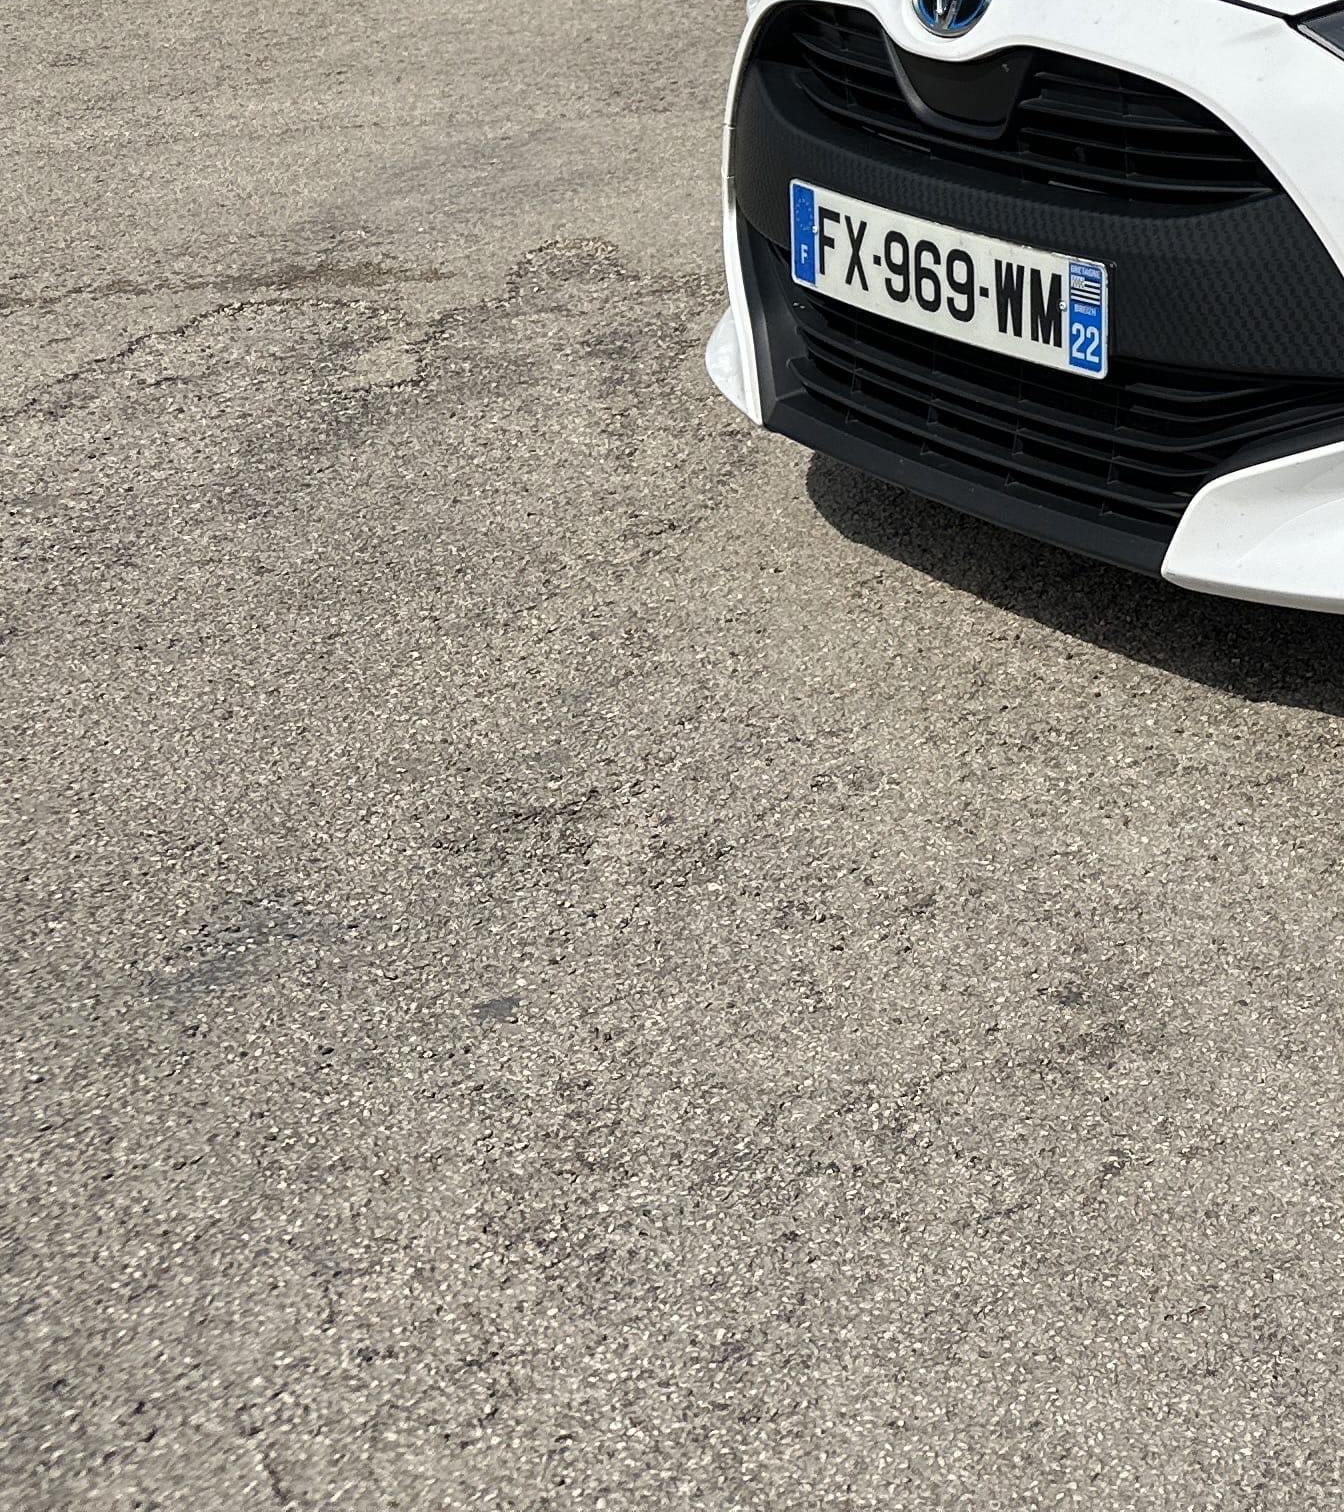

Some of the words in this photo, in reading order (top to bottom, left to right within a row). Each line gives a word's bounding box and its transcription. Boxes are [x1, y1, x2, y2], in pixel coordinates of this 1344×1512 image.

[801, 244, 808, 264] F
[817, 205, 1063, 348] FX-969-WM
[1071, 322, 1100, 364] 22
